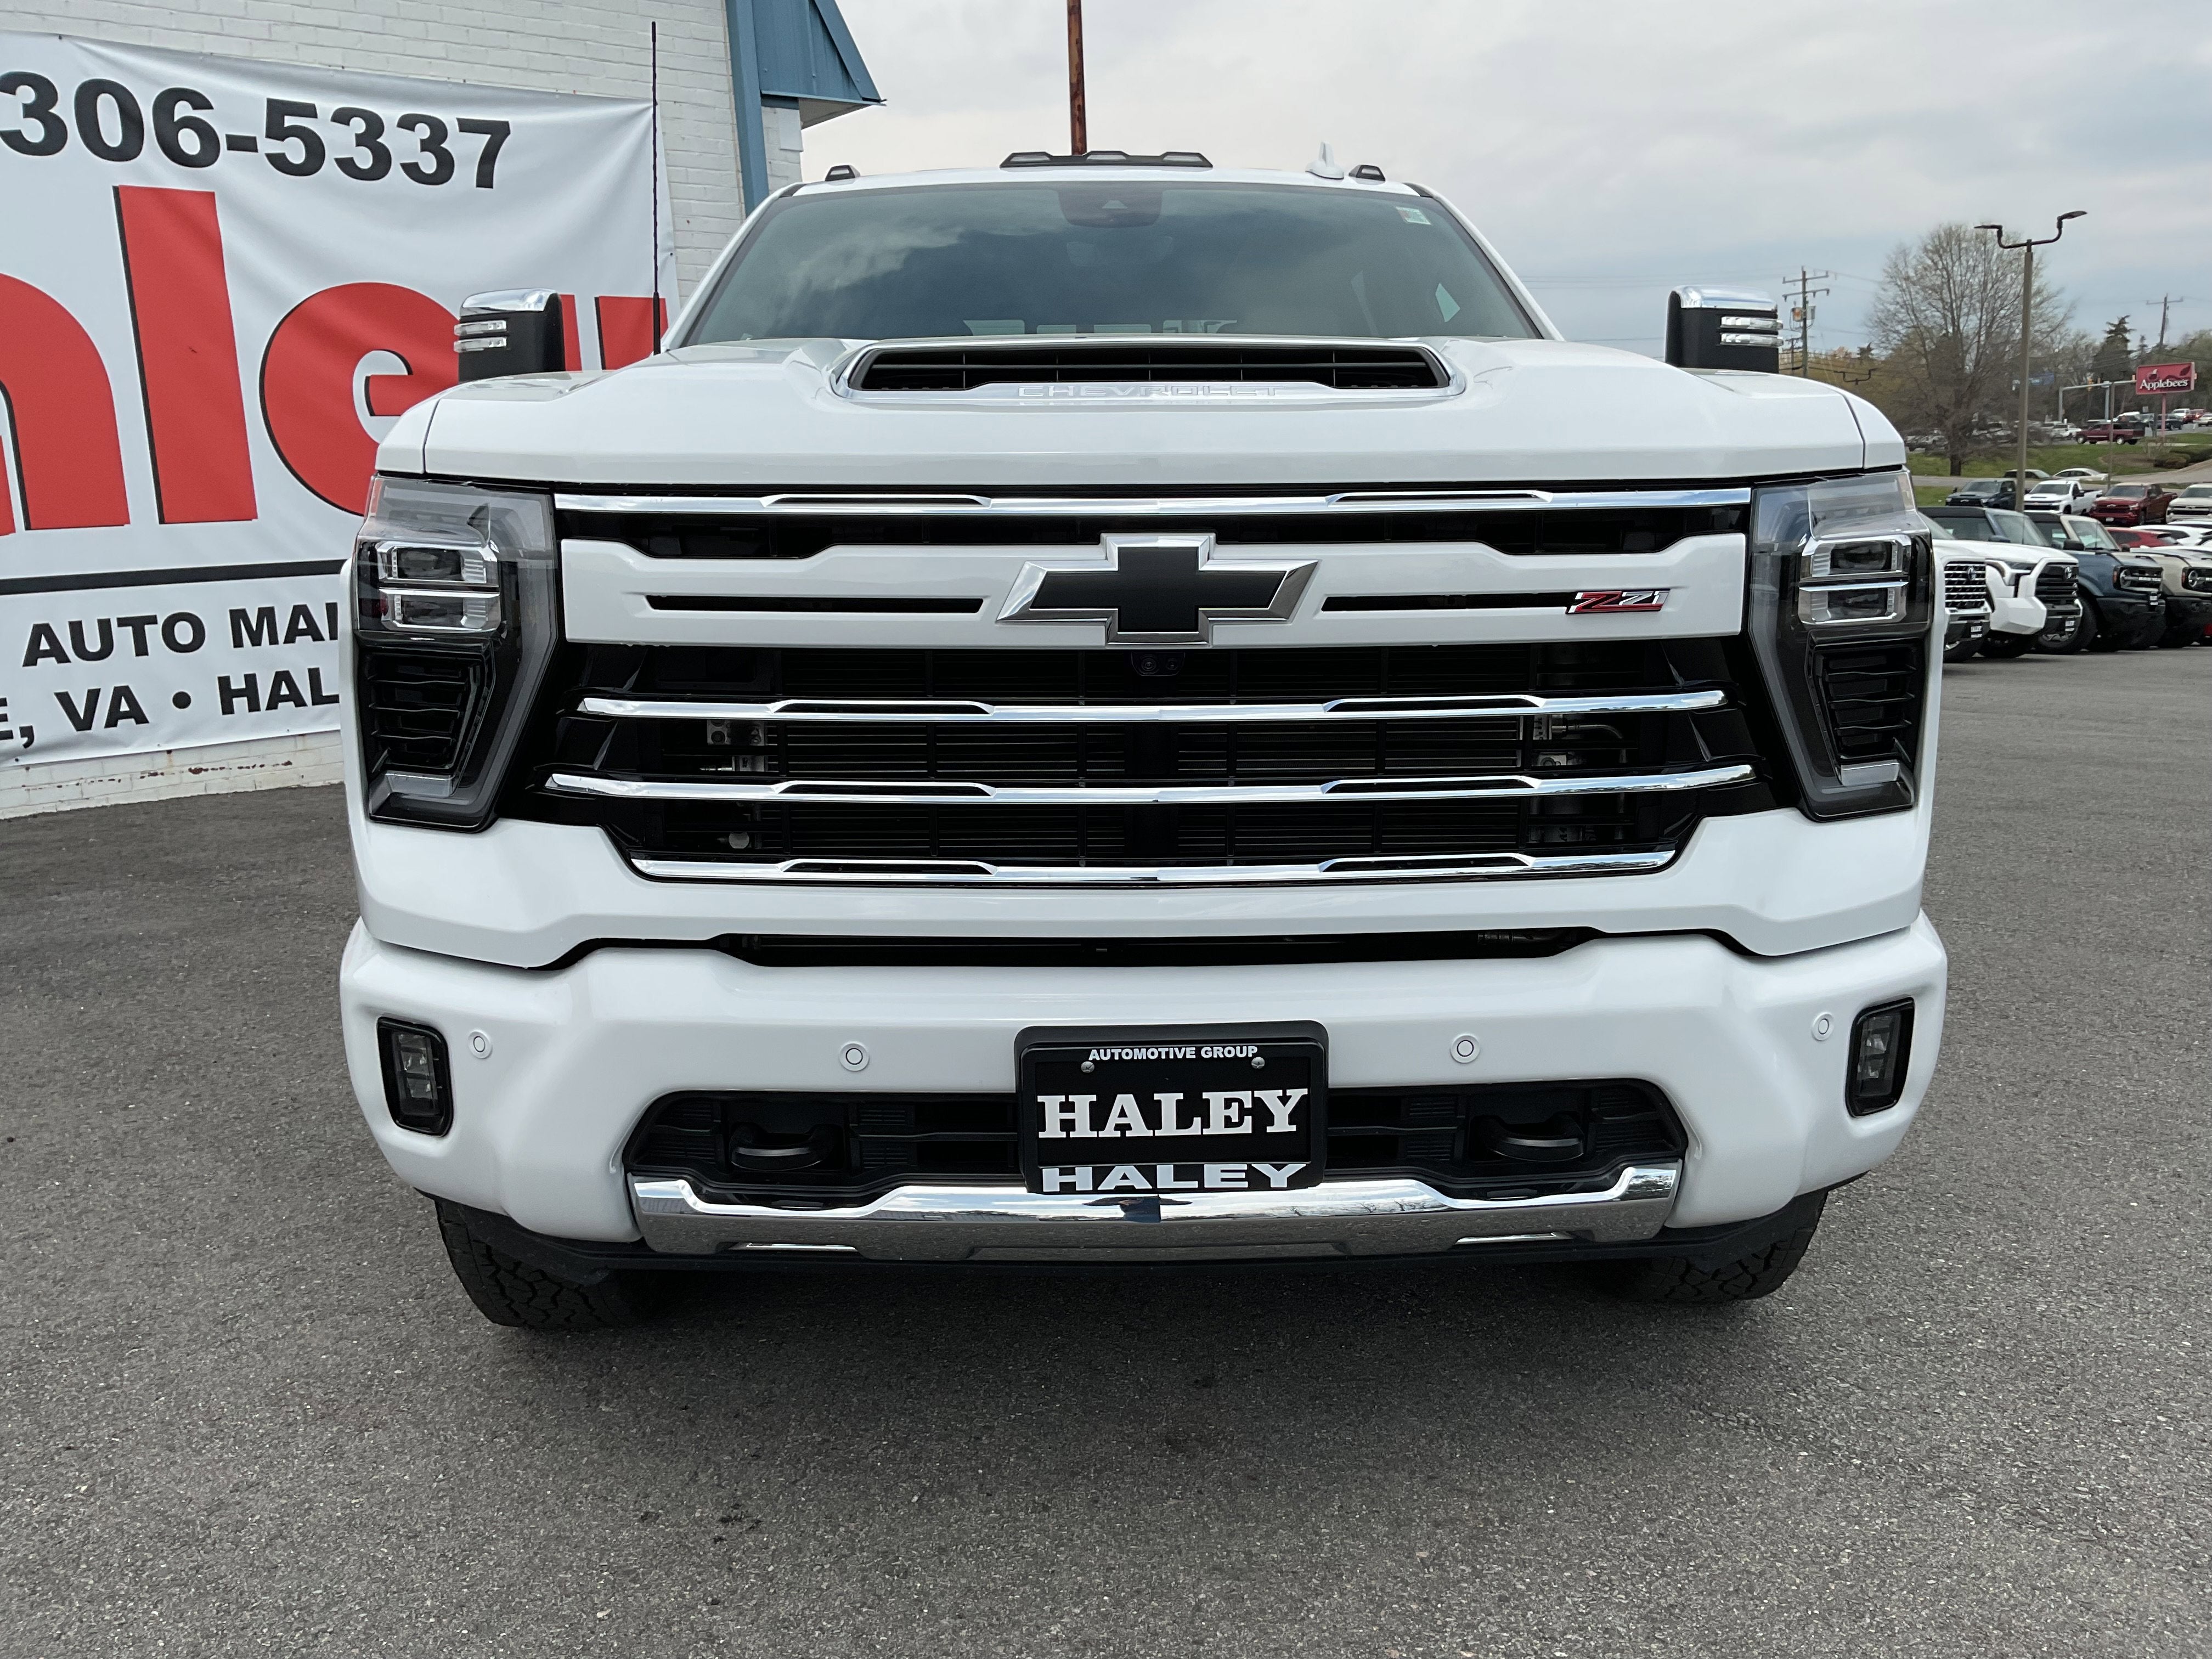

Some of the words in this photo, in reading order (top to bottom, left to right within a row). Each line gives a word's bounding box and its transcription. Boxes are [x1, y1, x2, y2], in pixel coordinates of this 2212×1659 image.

[0, 71, 511, 188] 306-5337
[1019, 386, 1284, 397] CHEVROLET
[2139, 379, 2188, 391] Applebee's
[1567, 590, 1670, 613] Z71
[22, 612, 206, 667] AUTO
[54, 685, 149, 732] VA
[1088, 1047, 1195, 1061] AUTOMOTIVE
[1201, 1046, 1258, 1059] GROUP
[1037, 1088, 1308, 1138] HALEY
[1042, 1164, 1306, 1192] HALEY
